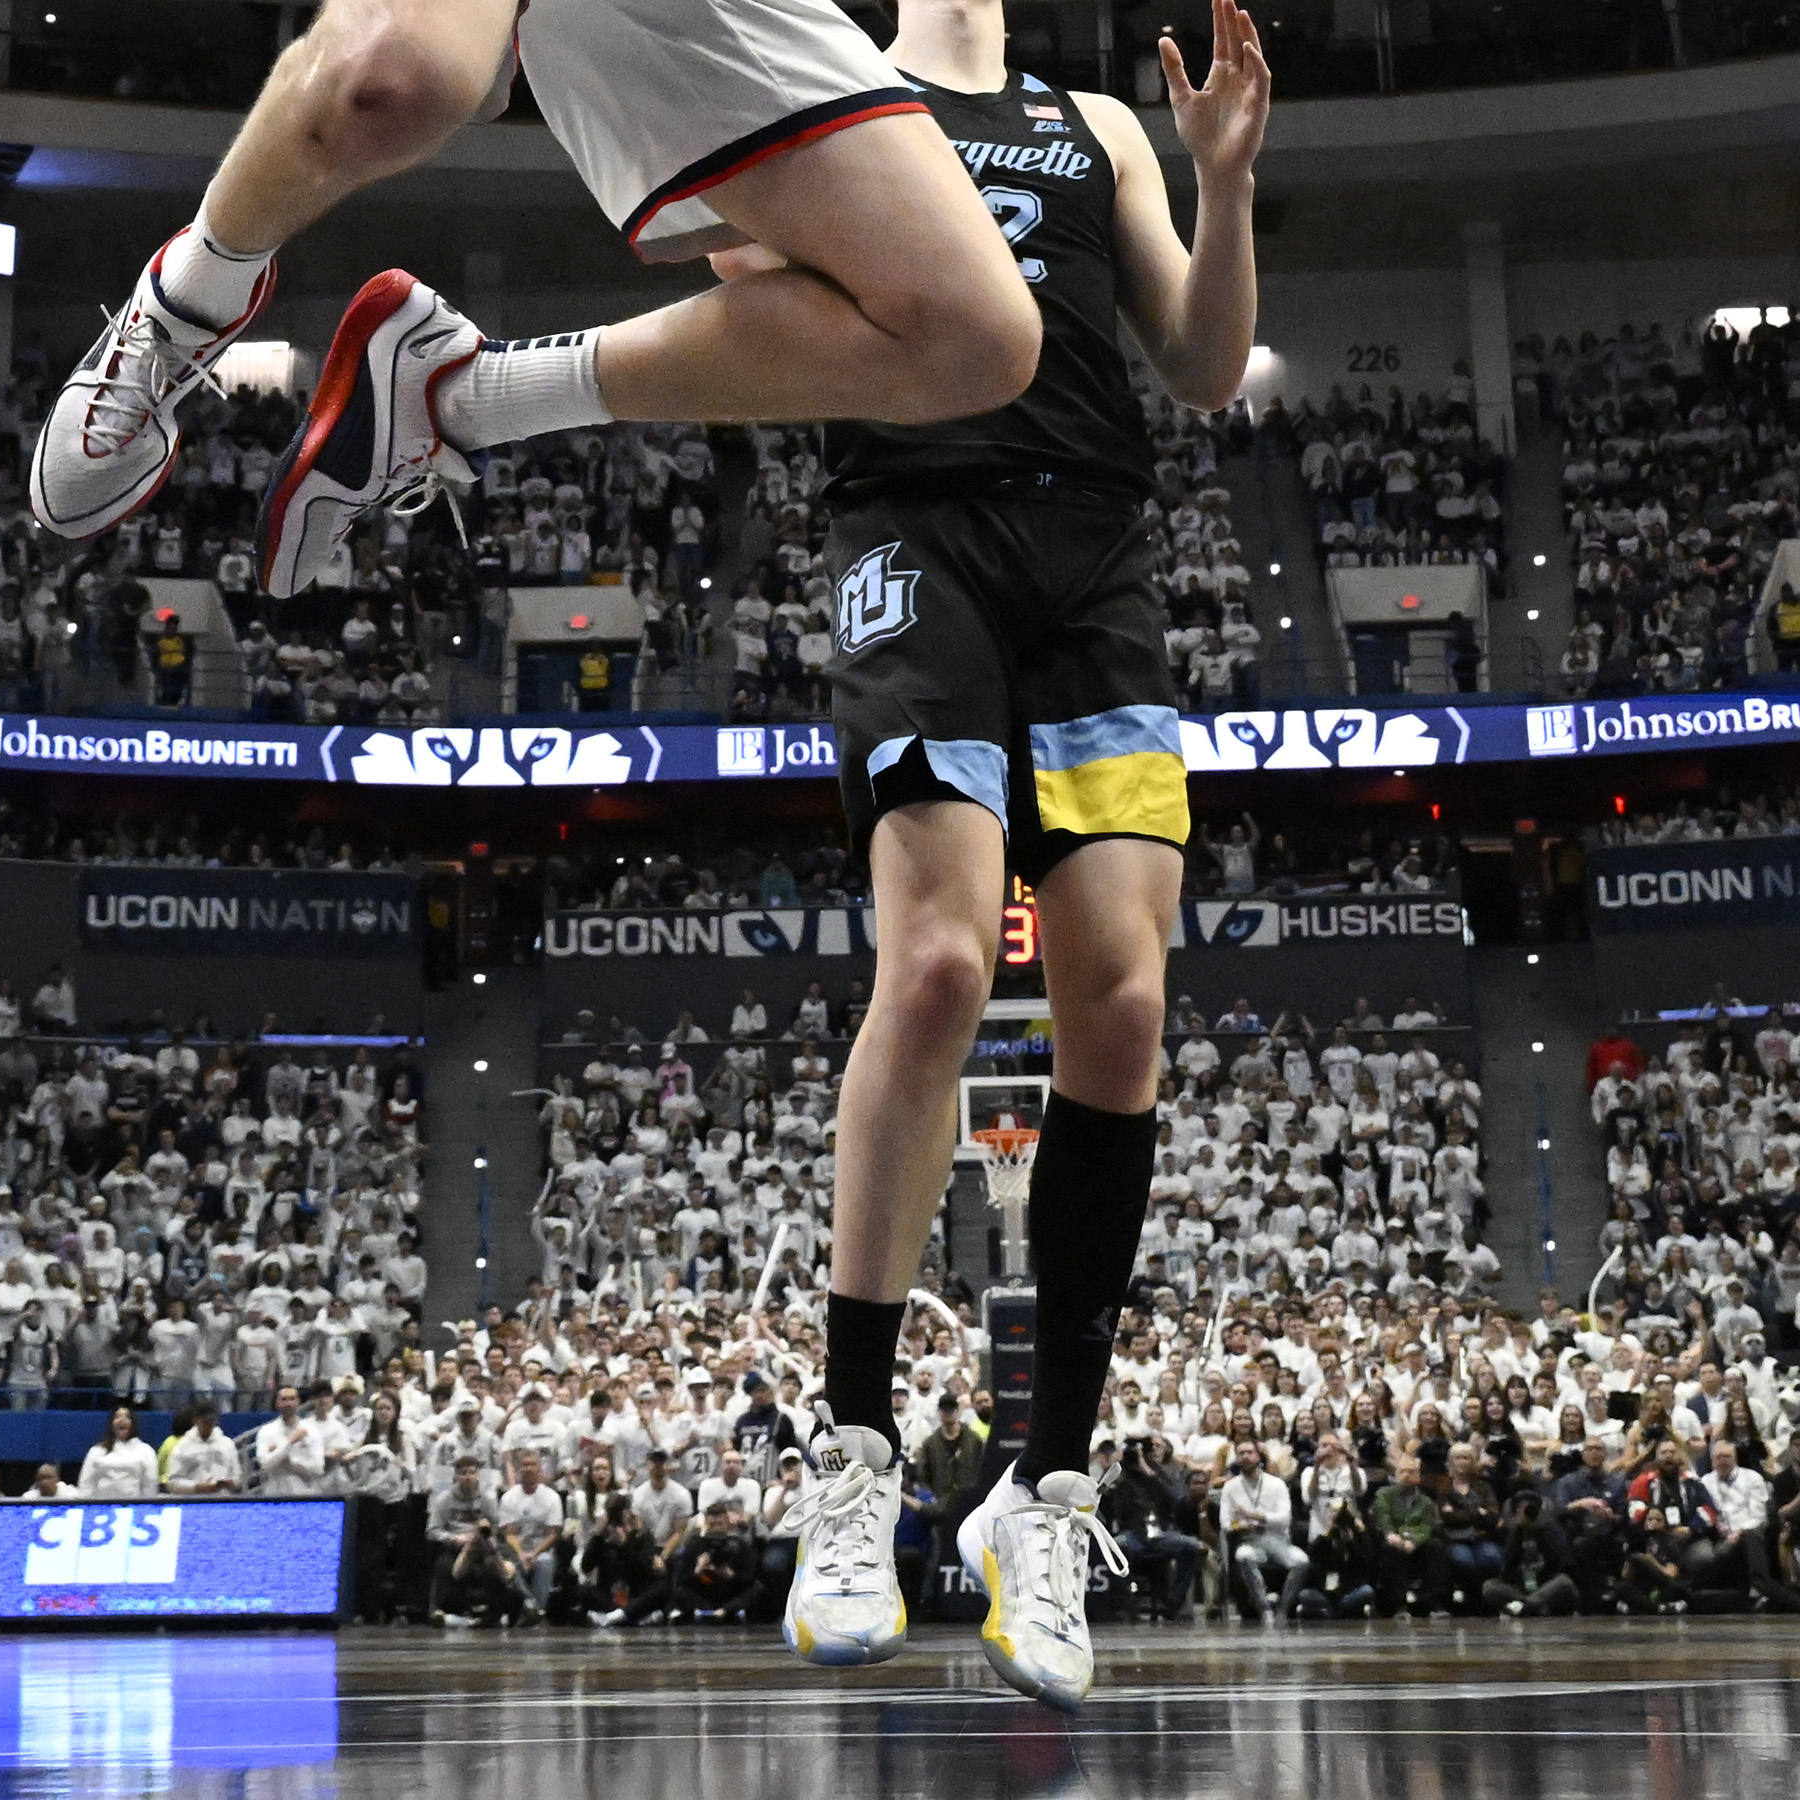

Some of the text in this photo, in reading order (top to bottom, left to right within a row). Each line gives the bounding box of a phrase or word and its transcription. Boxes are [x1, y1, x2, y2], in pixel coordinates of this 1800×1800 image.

[1346, 344, 1400, 374] 226
[835, 540, 923, 654] MU
[1598, 866, 1753, 908] UCONN
[85, 893, 239, 929] UCONN
[1279, 902, 1463, 938] HUSKIES
[545, 914, 721, 957] UCONN
[32, 1505, 162, 1550] CBS
